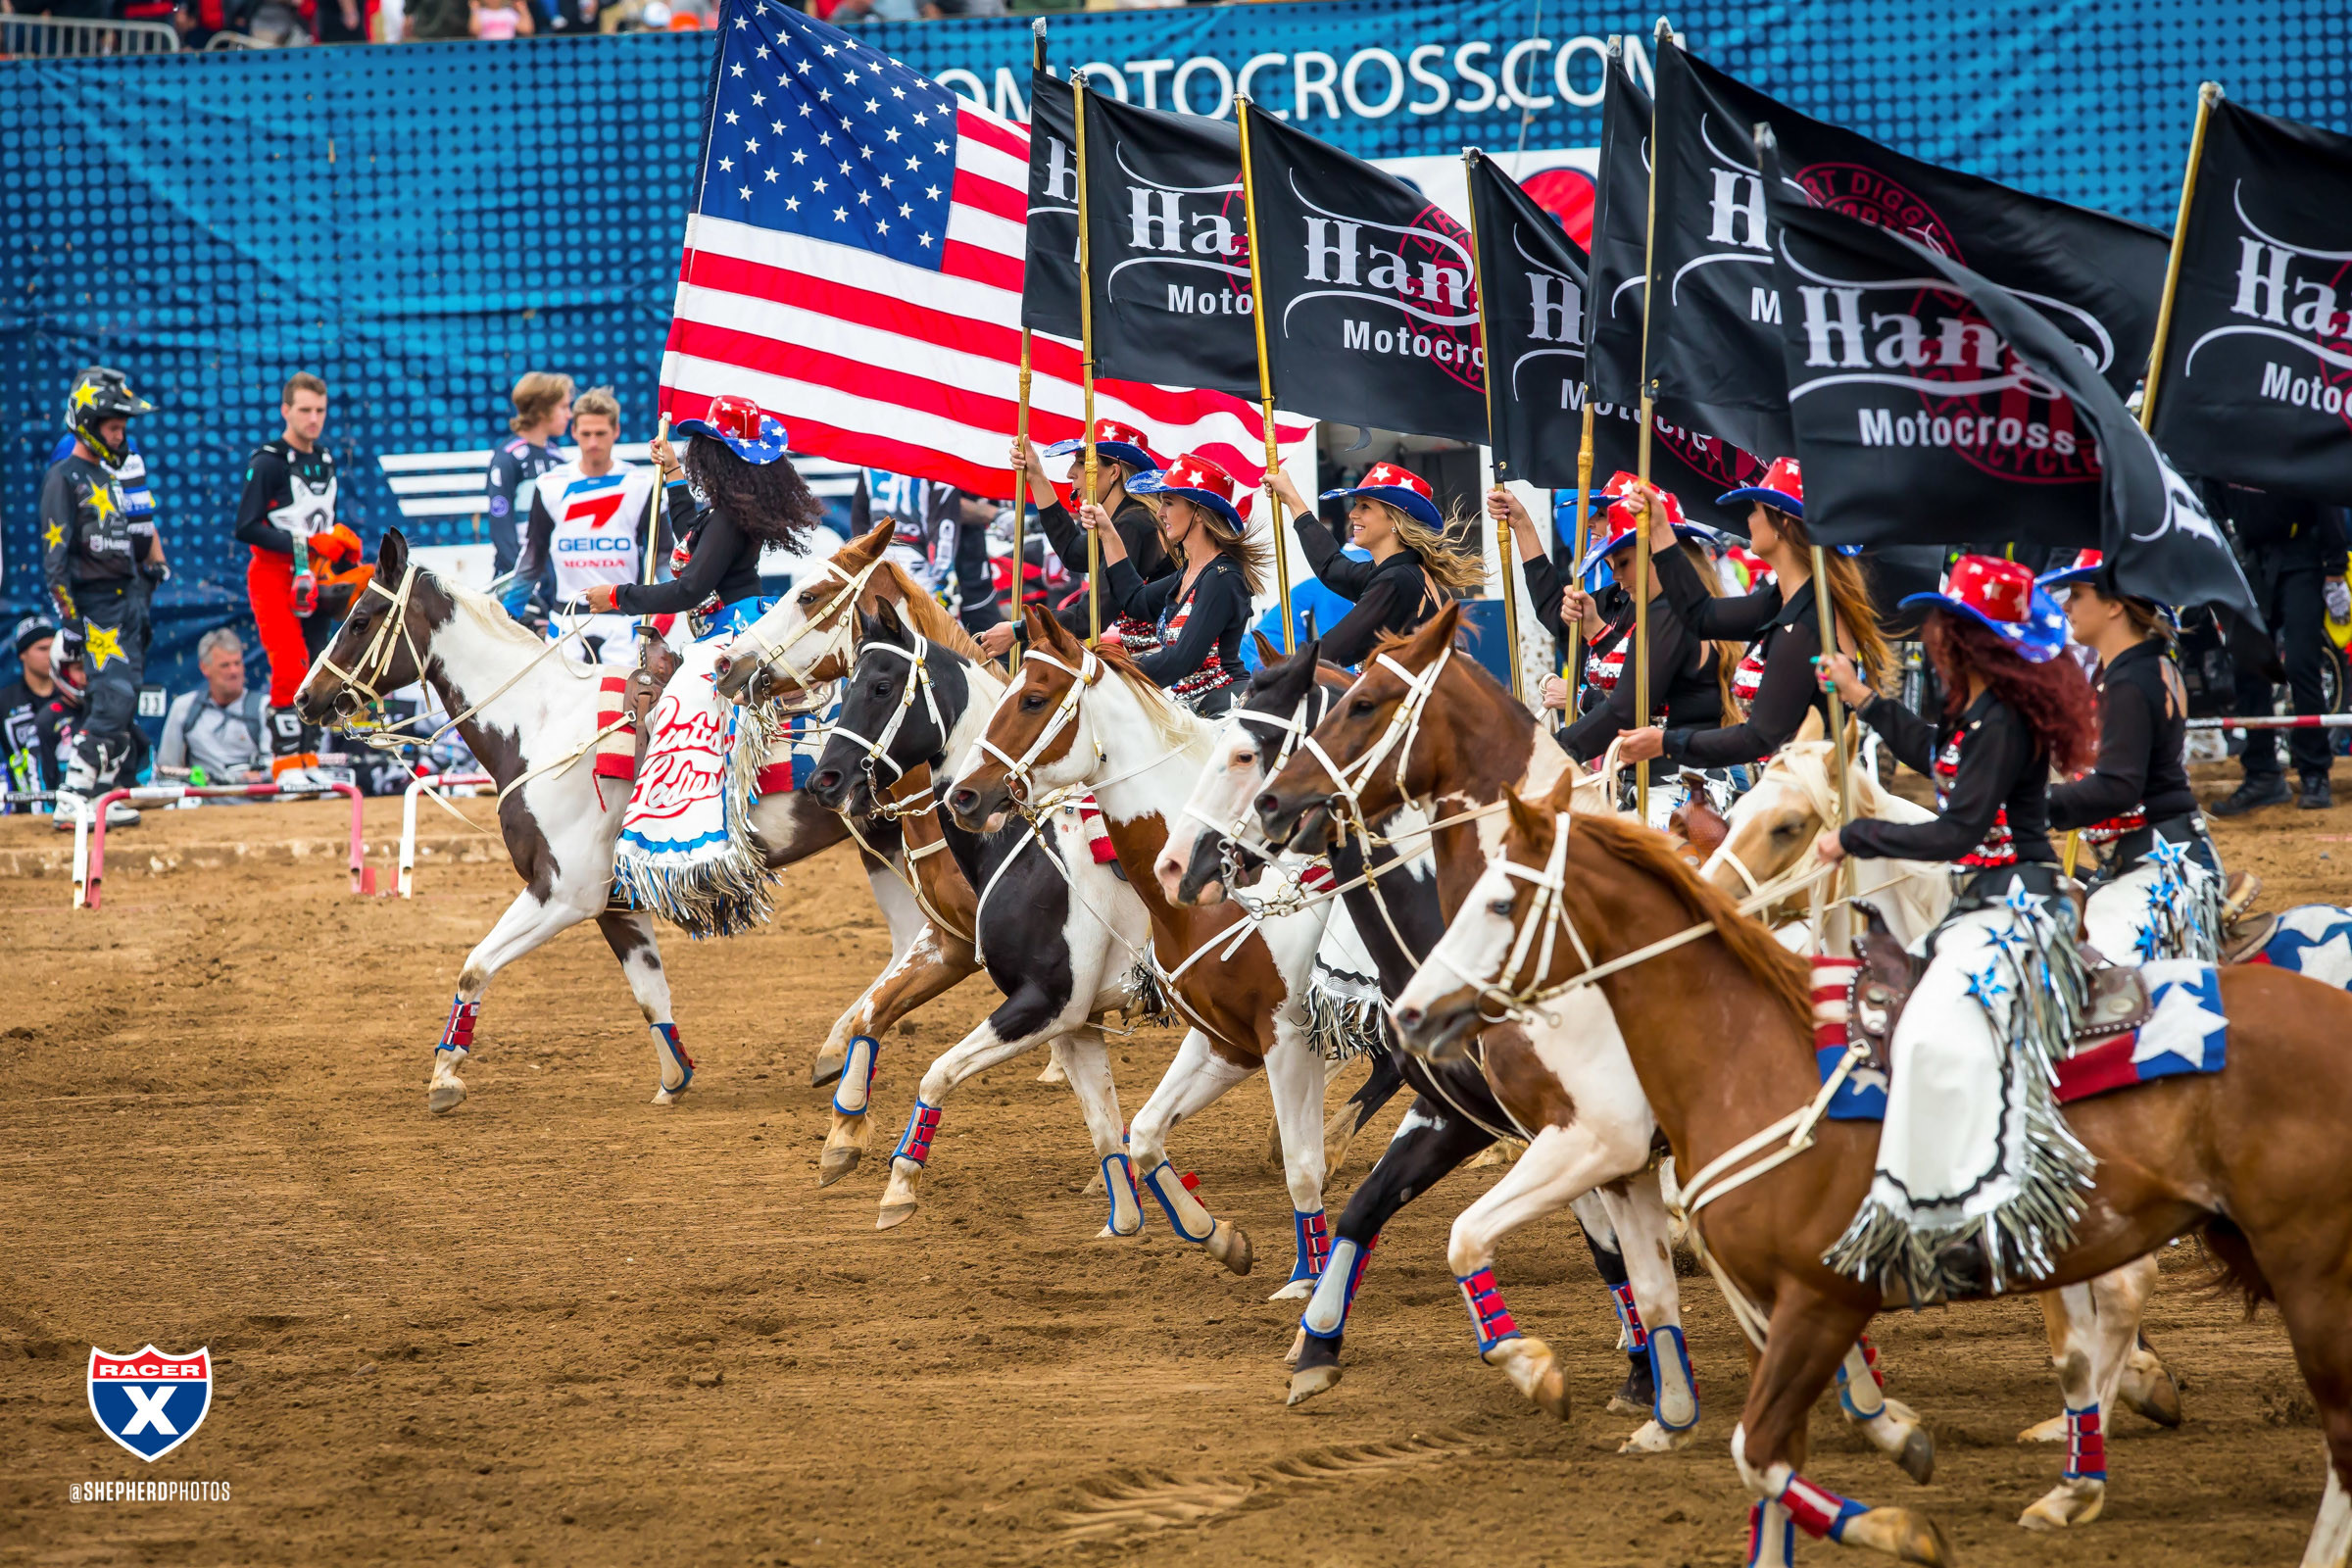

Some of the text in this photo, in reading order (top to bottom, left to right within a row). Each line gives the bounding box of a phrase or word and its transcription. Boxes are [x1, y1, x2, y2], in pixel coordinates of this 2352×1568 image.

[1126, 185, 1250, 257] Ha
[1301, 215, 1479, 312] Han
[2230, 235, 2352, 340] Ha
[1858, 408, 2077, 456] Motocross
[557, 537, 631, 552] GEICO
[564, 558, 626, 568] HONDA
